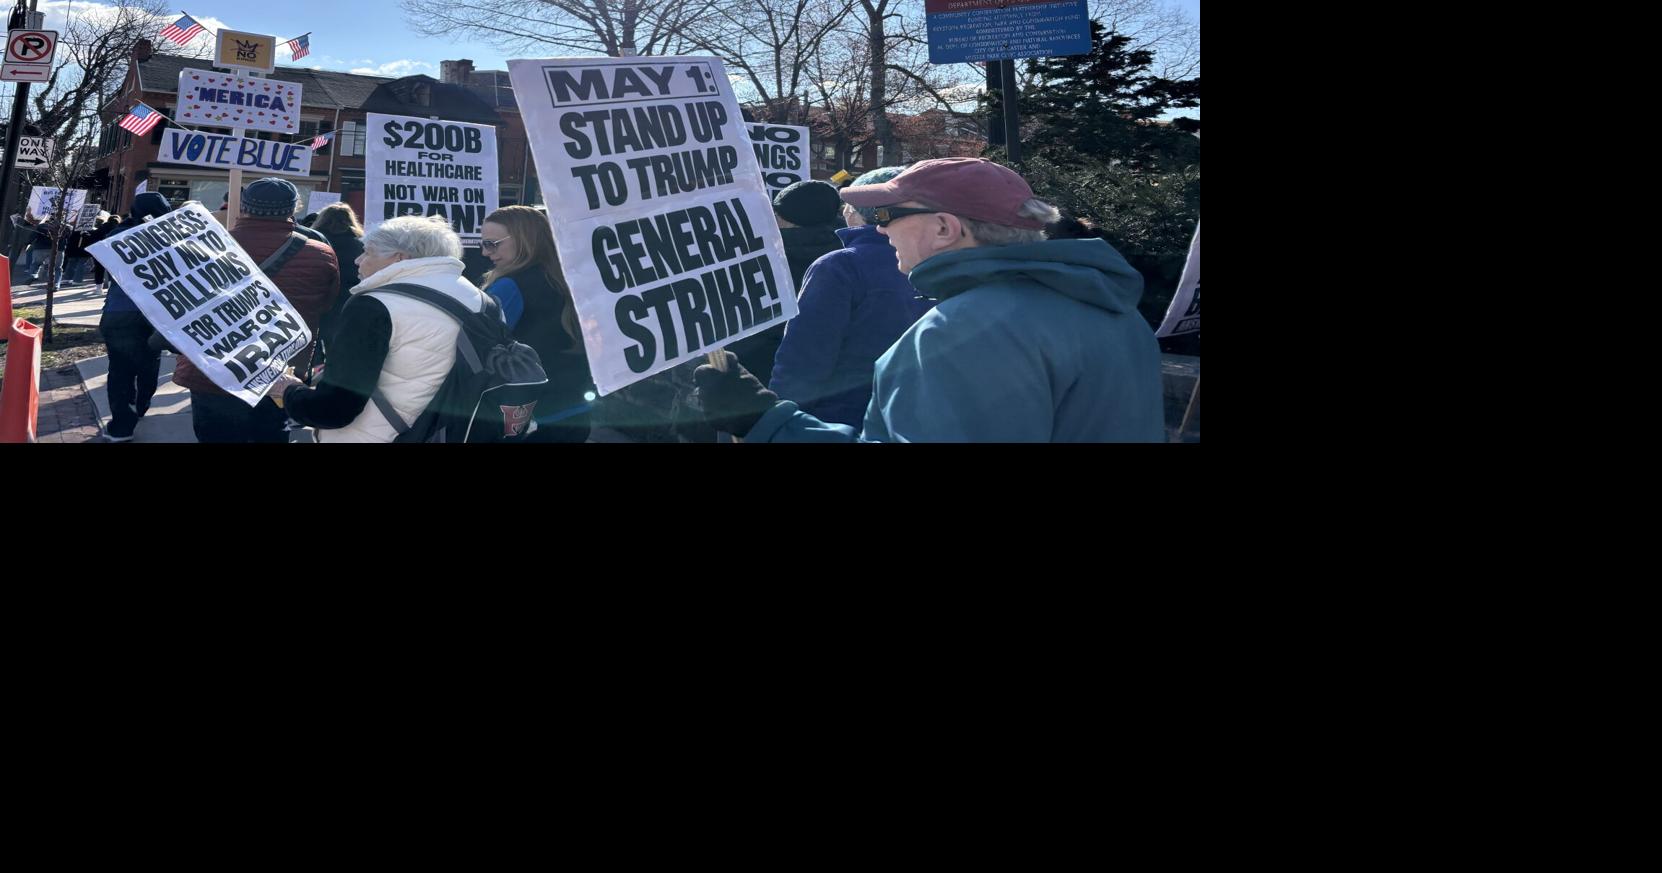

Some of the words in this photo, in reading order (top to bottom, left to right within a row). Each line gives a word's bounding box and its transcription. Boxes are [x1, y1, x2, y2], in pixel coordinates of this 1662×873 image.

[237, 51, 257, 59] NO
[194, 87, 287, 113] 'MERICA
[548, 66, 675, 102] MAY
[687, 65, 716, 93] 1:
[20, 138, 50, 148] ONE
[383, 120, 482, 154] $200B
[559, 104, 687, 160] STAND
[690, 101, 728, 143] UP
[748, 126, 801, 143] NO
[20, 147, 48, 157] WAY
[172, 132, 237, 162] VOTE
[237, 138, 306, 172] BLUE
[385, 160, 482, 180] HEALTHCARE
[418, 151, 454, 162] FOR
[753, 143, 801, 171] NGS
[384, 184, 416, 200] NOT
[422, 185, 459, 203] WAR
[463, 188, 485, 203] ON
[571, 161, 628, 211] TO
[626, 146, 738, 200] TRUMP
[761, 171, 802, 188] O
[111, 209, 209, 265] CONGRESS:
[591, 198, 764, 294] GENERAL
[133, 251, 181, 291] SAY
[174, 240, 206, 270] NO
[199, 230, 227, 256] TO
[152, 252, 252, 320] BILLIONS
[182, 313, 222, 346] FOR
[212, 279, 271, 327] TRUMP'S
[204, 321, 260, 360] WAR
[255, 300, 284, 325] ON
[614, 254, 782, 374] STRIKE!
[224, 313, 302, 383] IRAN
